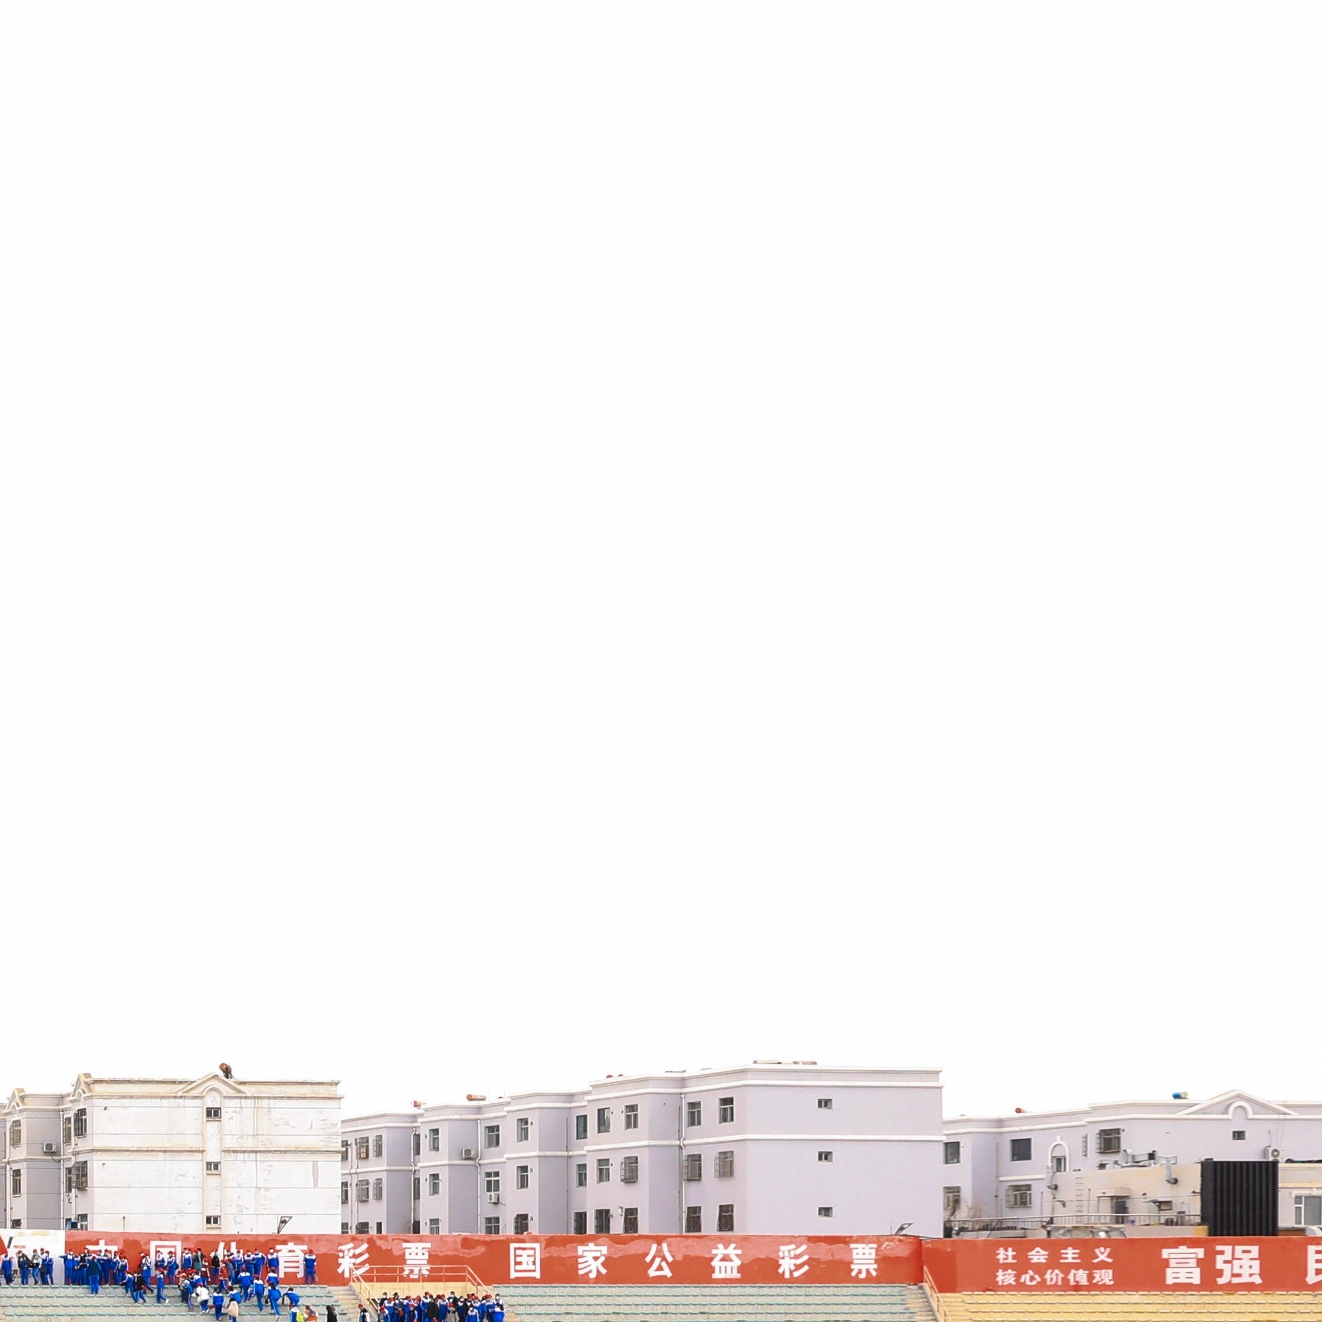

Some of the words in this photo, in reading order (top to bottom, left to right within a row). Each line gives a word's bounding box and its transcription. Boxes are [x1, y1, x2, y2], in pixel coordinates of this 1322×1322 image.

[509, 1242, 878, 1279] 国家公益彩票
[996, 1247, 1114, 1263] 社会主义
[1161, 1245, 1263, 1285] 富强
[995, 1268, 1115, 1286] 核心价值观
